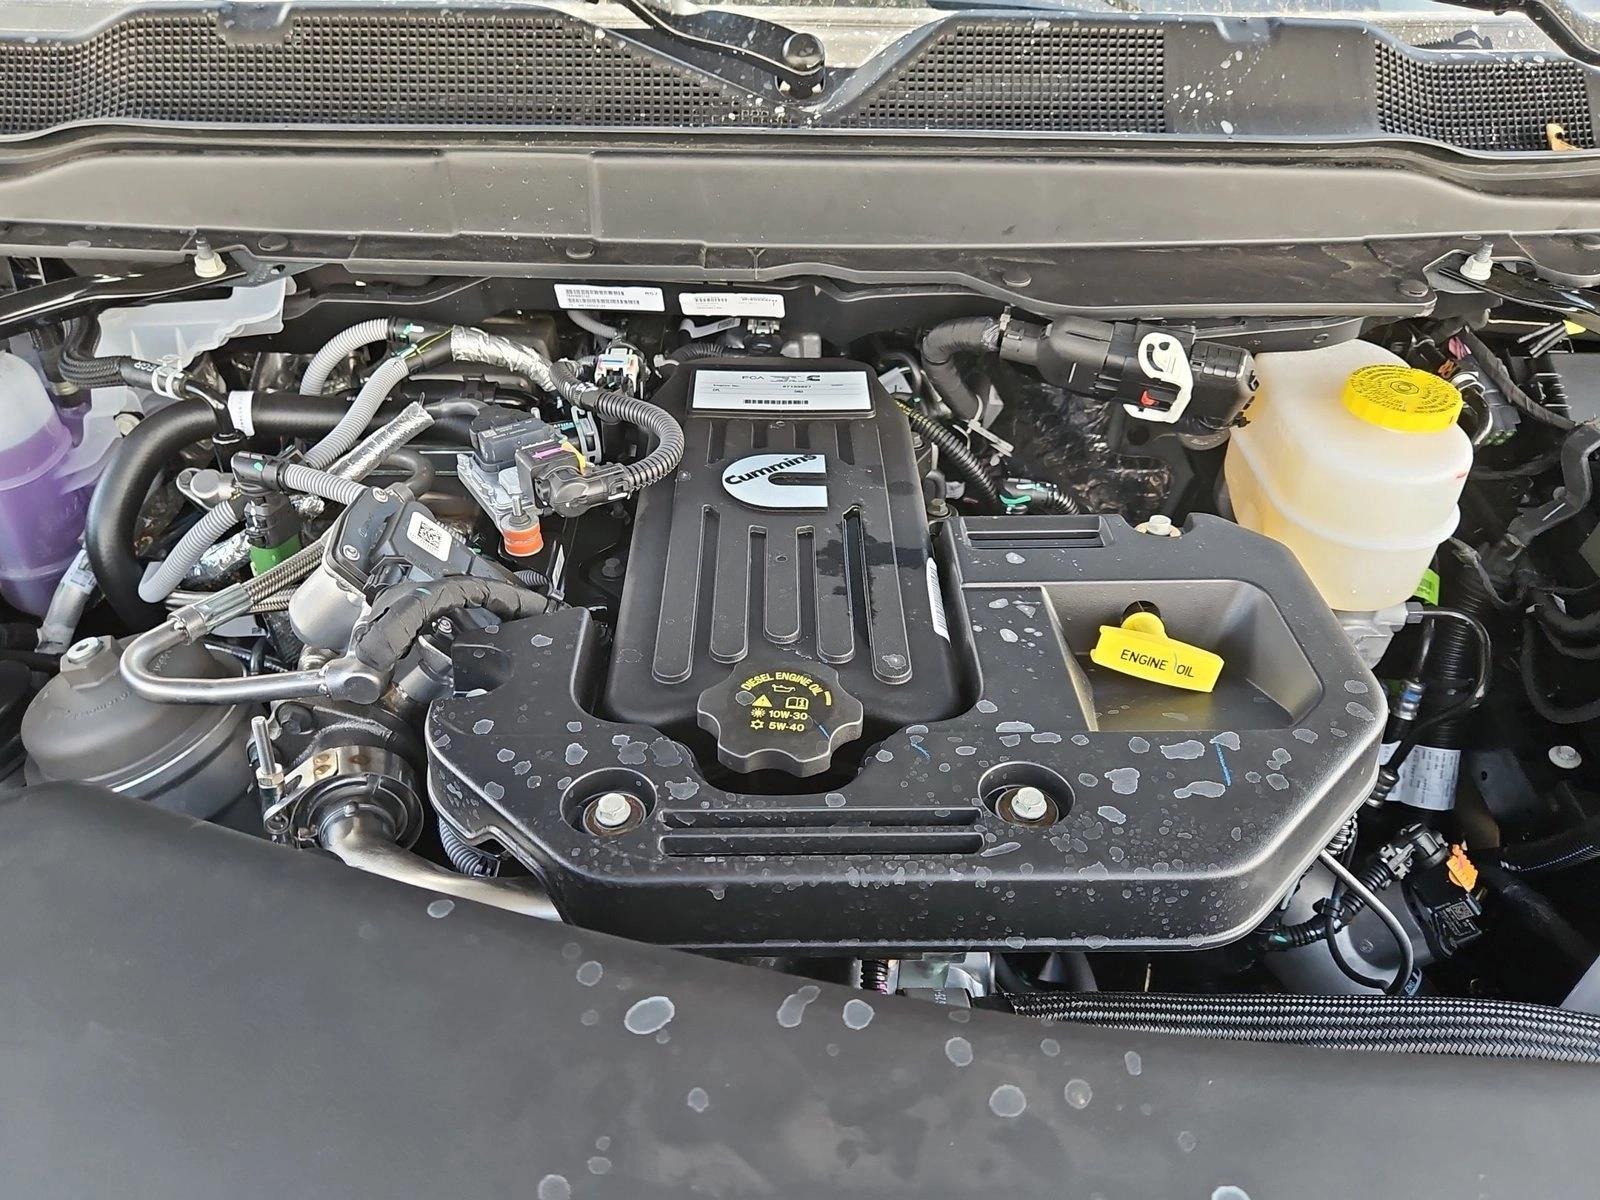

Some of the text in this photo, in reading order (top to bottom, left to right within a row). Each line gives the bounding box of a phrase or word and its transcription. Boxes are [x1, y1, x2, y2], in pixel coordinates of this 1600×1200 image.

[724, 455, 817, 485] Cummins
[1120, 649, 1195, 678] ENGINE OIL
[741, 671, 824, 696] DIESEL ENGINE OIL
[768, 721, 805, 732] 5W-40
[769, 709, 808, 720] 10W-30
